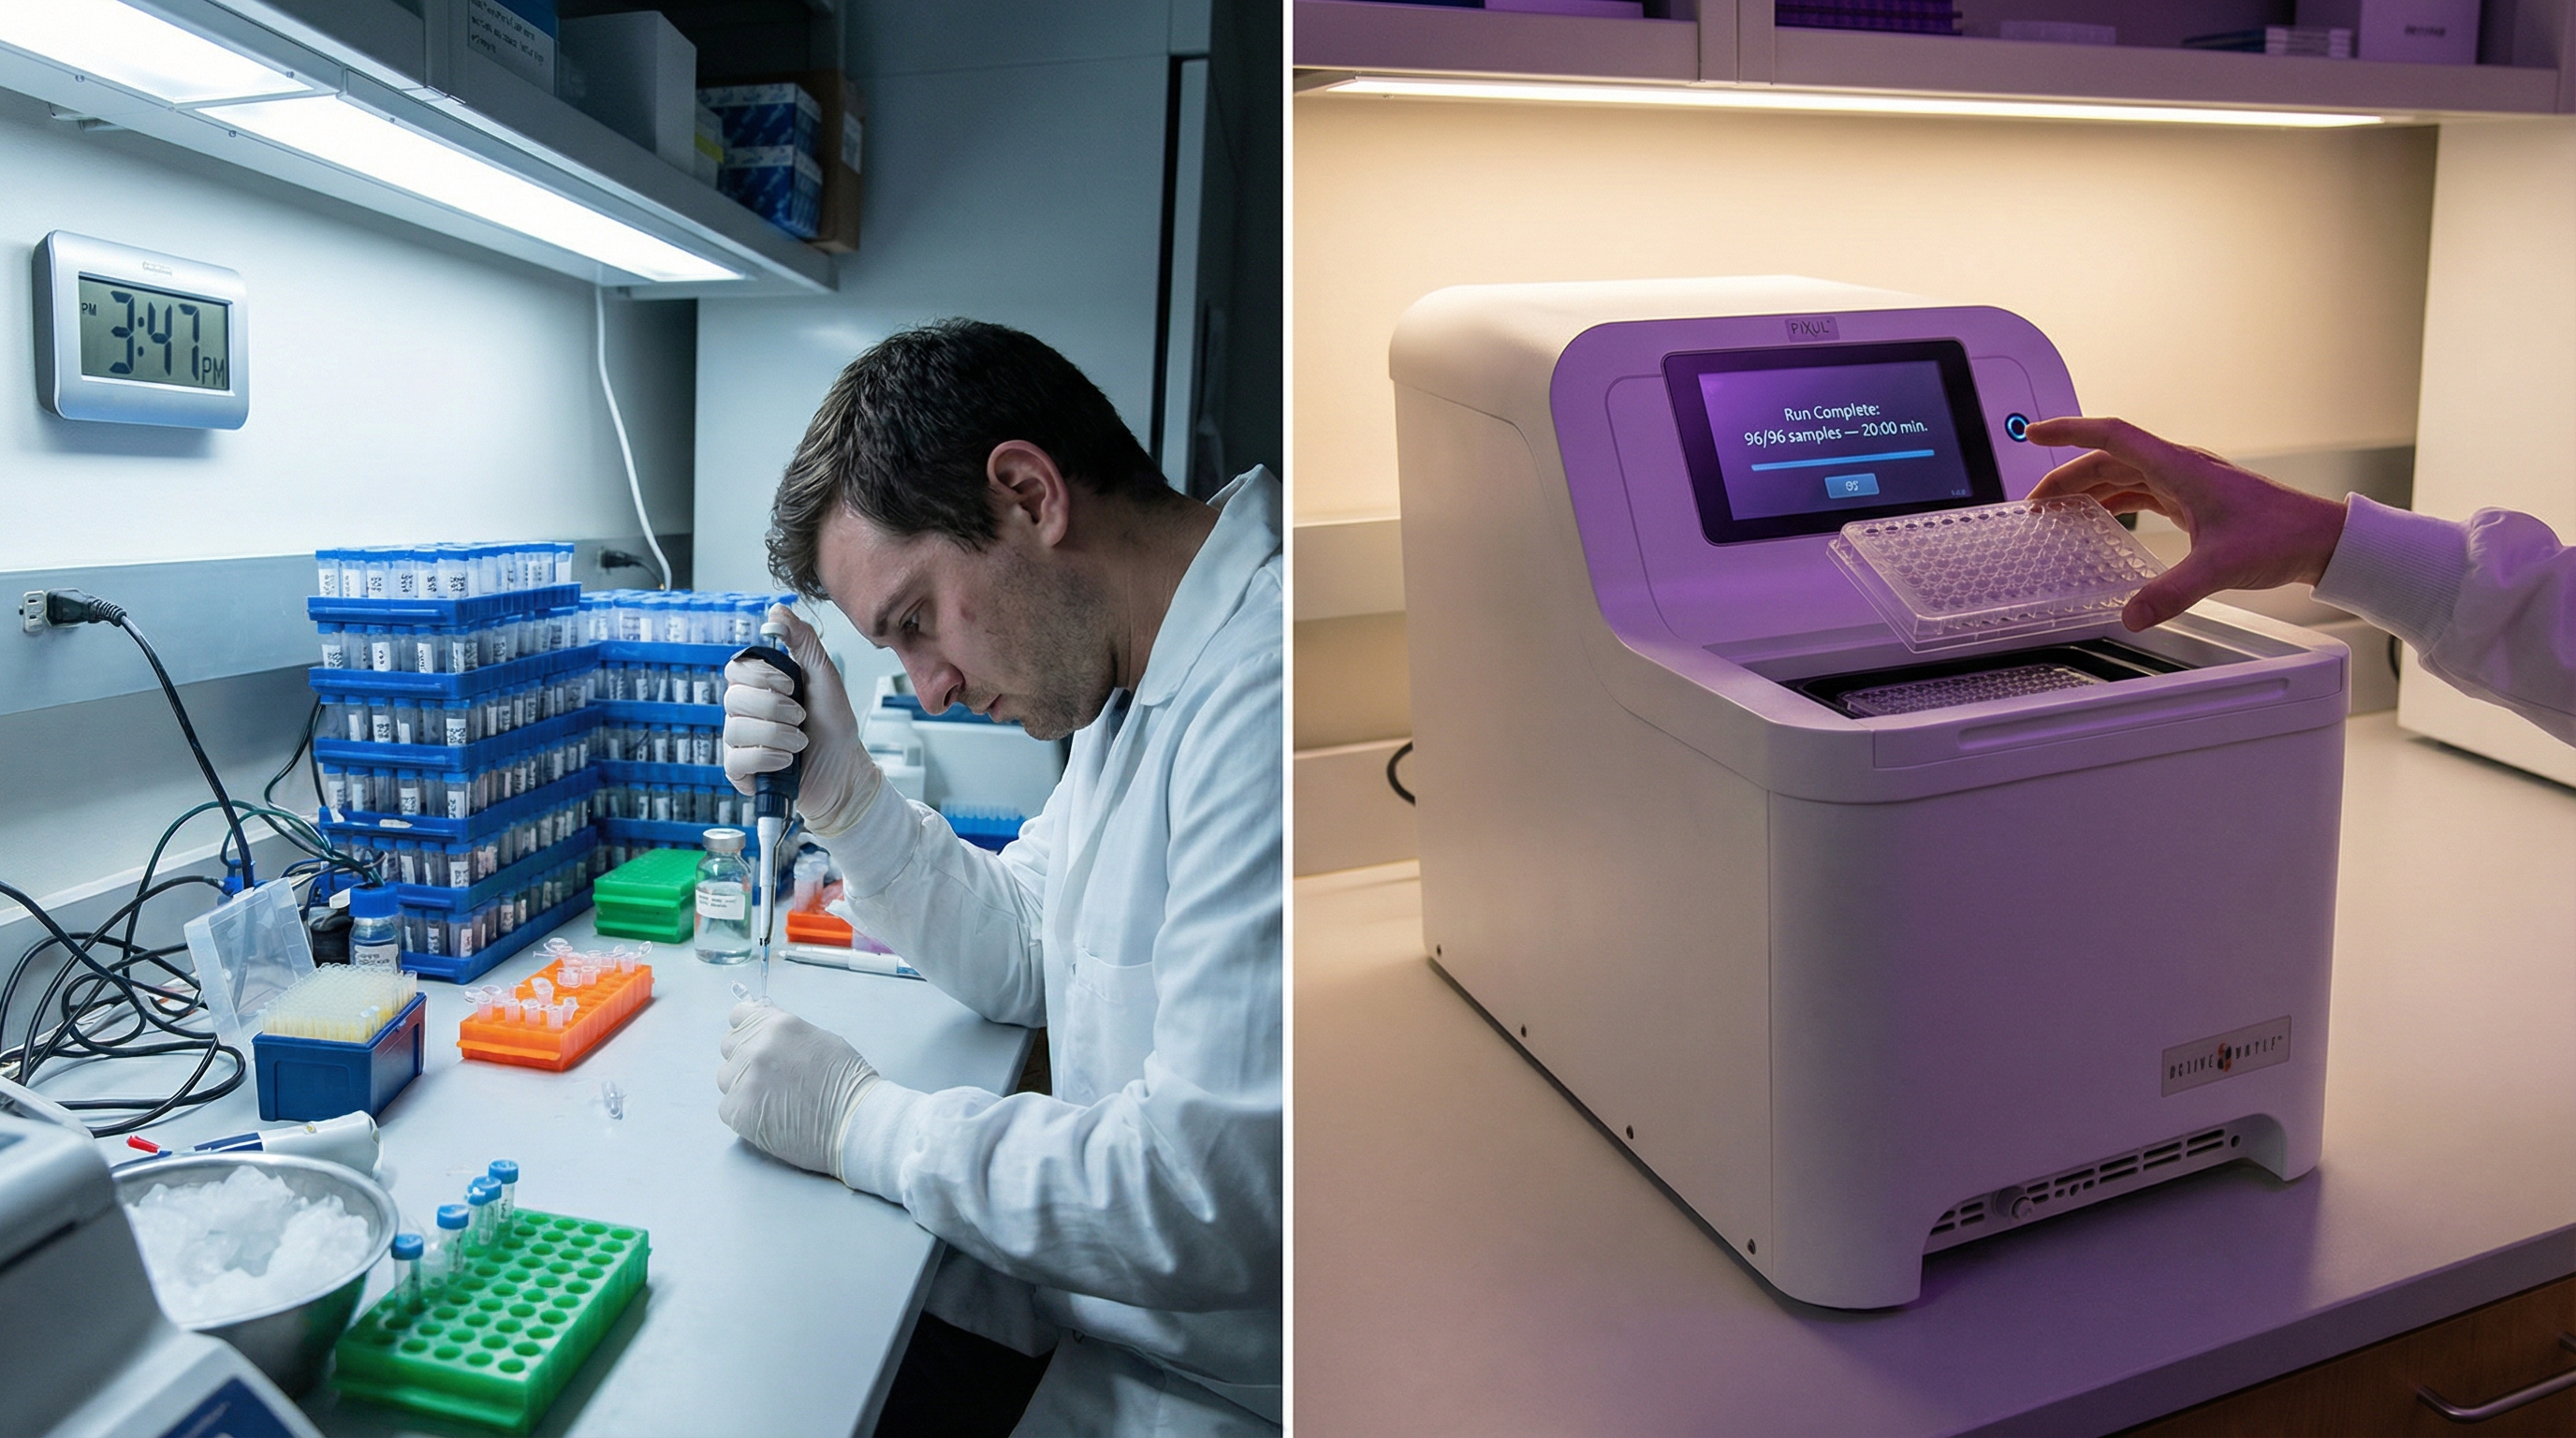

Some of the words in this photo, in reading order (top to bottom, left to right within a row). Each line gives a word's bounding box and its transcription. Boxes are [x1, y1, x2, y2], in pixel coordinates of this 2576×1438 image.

[81, 302, 97, 316] PM
[109, 290, 200, 381] 3:47
[201, 356, 226, 388] PM
[1784, 407, 1811, 421] Run
[1813, 403, 1881, 421] Complete:
[1744, 429, 1786, 448] 96/96
[1788, 426, 1842, 445] samples
[1861, 421, 1897, 437] 20:00
[1899, 419, 1928, 434] min.
